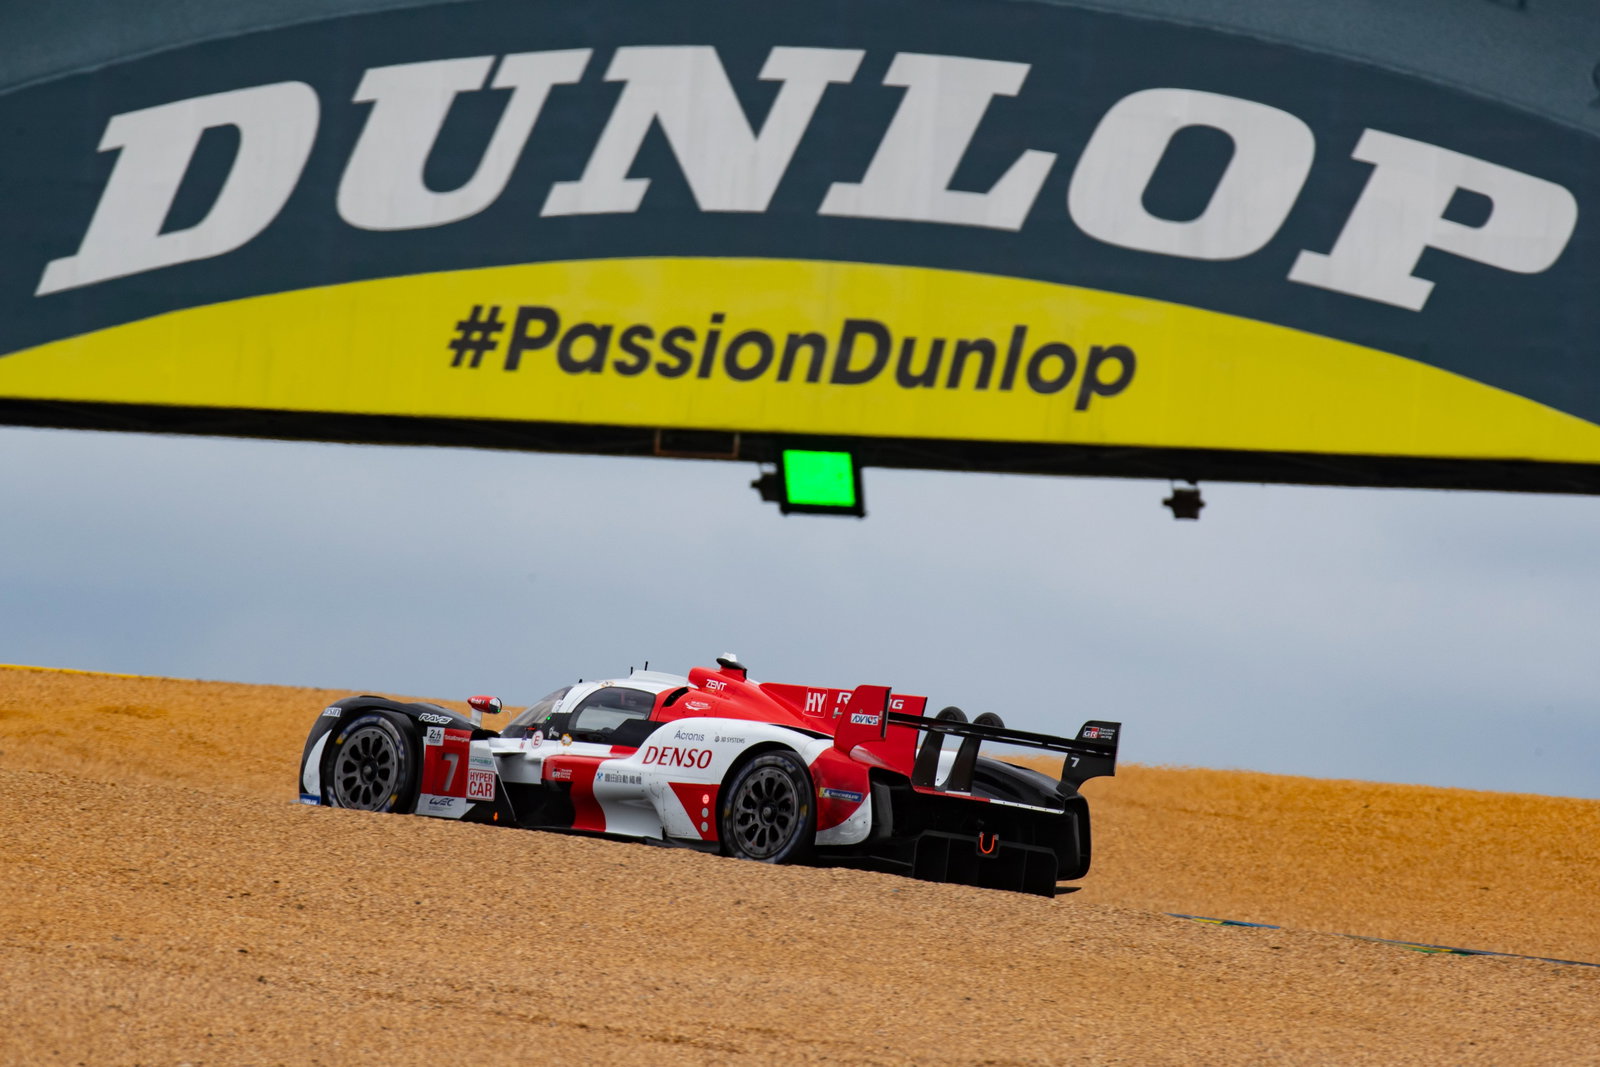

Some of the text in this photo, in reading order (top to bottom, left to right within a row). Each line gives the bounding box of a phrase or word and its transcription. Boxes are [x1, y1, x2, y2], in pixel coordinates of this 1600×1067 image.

[34, 45, 1578, 312] DUNLOP
[448, 304, 1137, 412] #PassionDunlop
[705, 679, 727, 691] ZENT
[805, 692, 826, 713] HY
[419, 712, 453, 724] RAYS
[674, 730, 705, 742] Acronis
[642, 746, 713, 769] DENSO
[1071, 757, 1080, 768] 7
[443, 752, 460, 792] 7
[469, 772, 493, 783] HYPER
[469, 781, 493, 797] CAR
[429, 797, 455, 807] WEC
